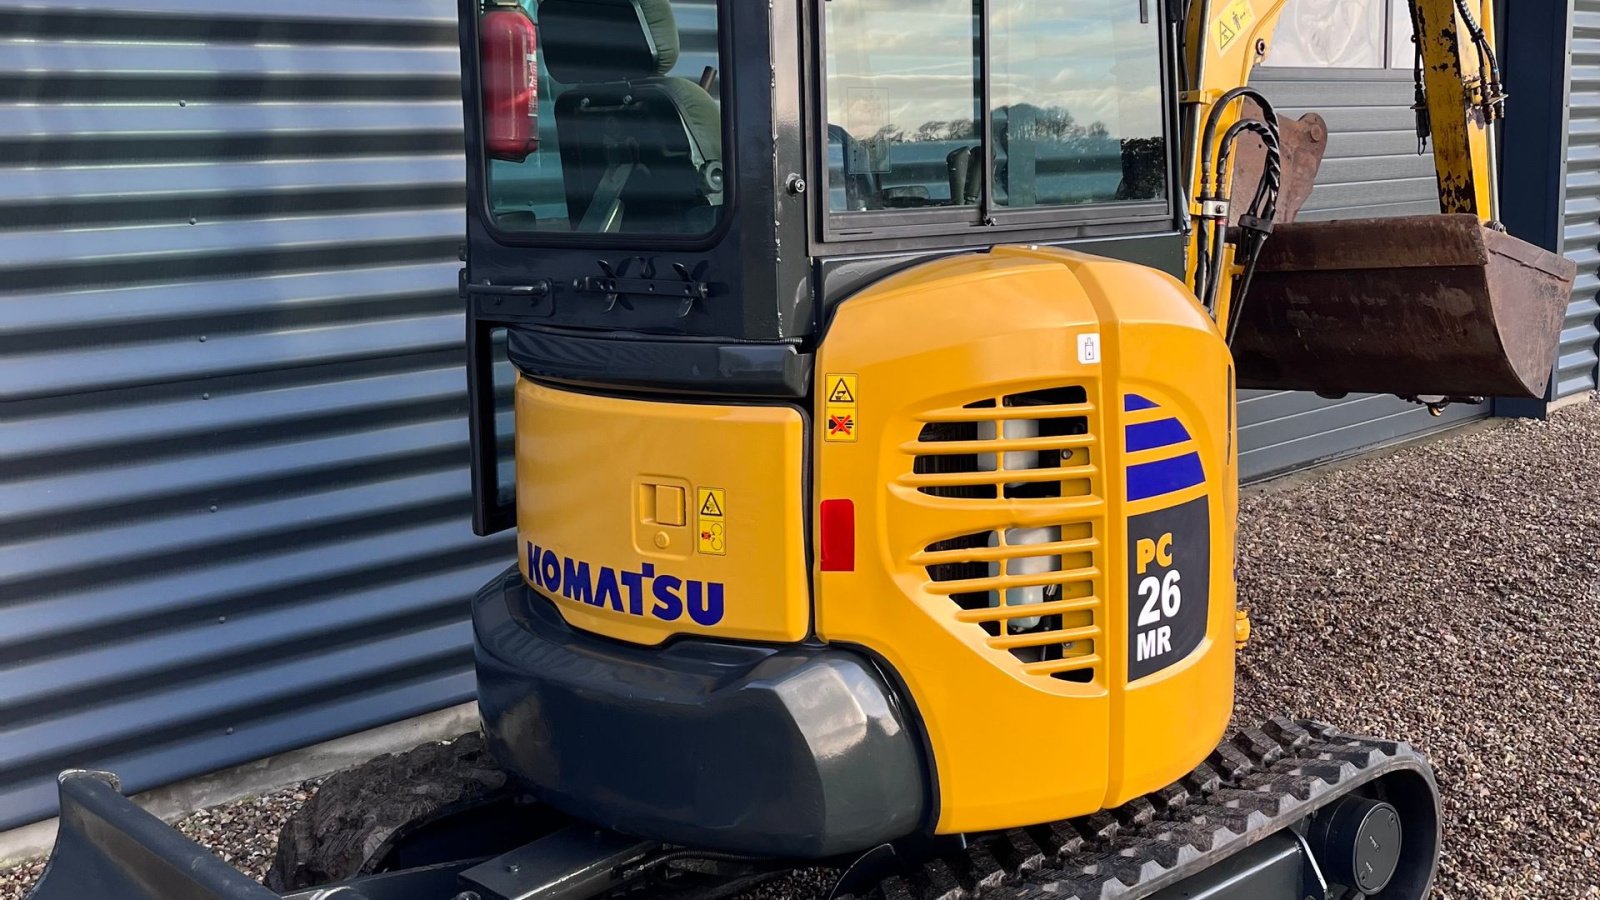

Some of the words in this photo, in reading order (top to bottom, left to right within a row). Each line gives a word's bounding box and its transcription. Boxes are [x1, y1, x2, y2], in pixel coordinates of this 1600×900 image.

[1137, 532, 1173, 574] PC
[527, 541, 724, 626] KOMATSU
[1137, 569, 1181, 627] 26
[1136, 625, 1172, 662] MR
